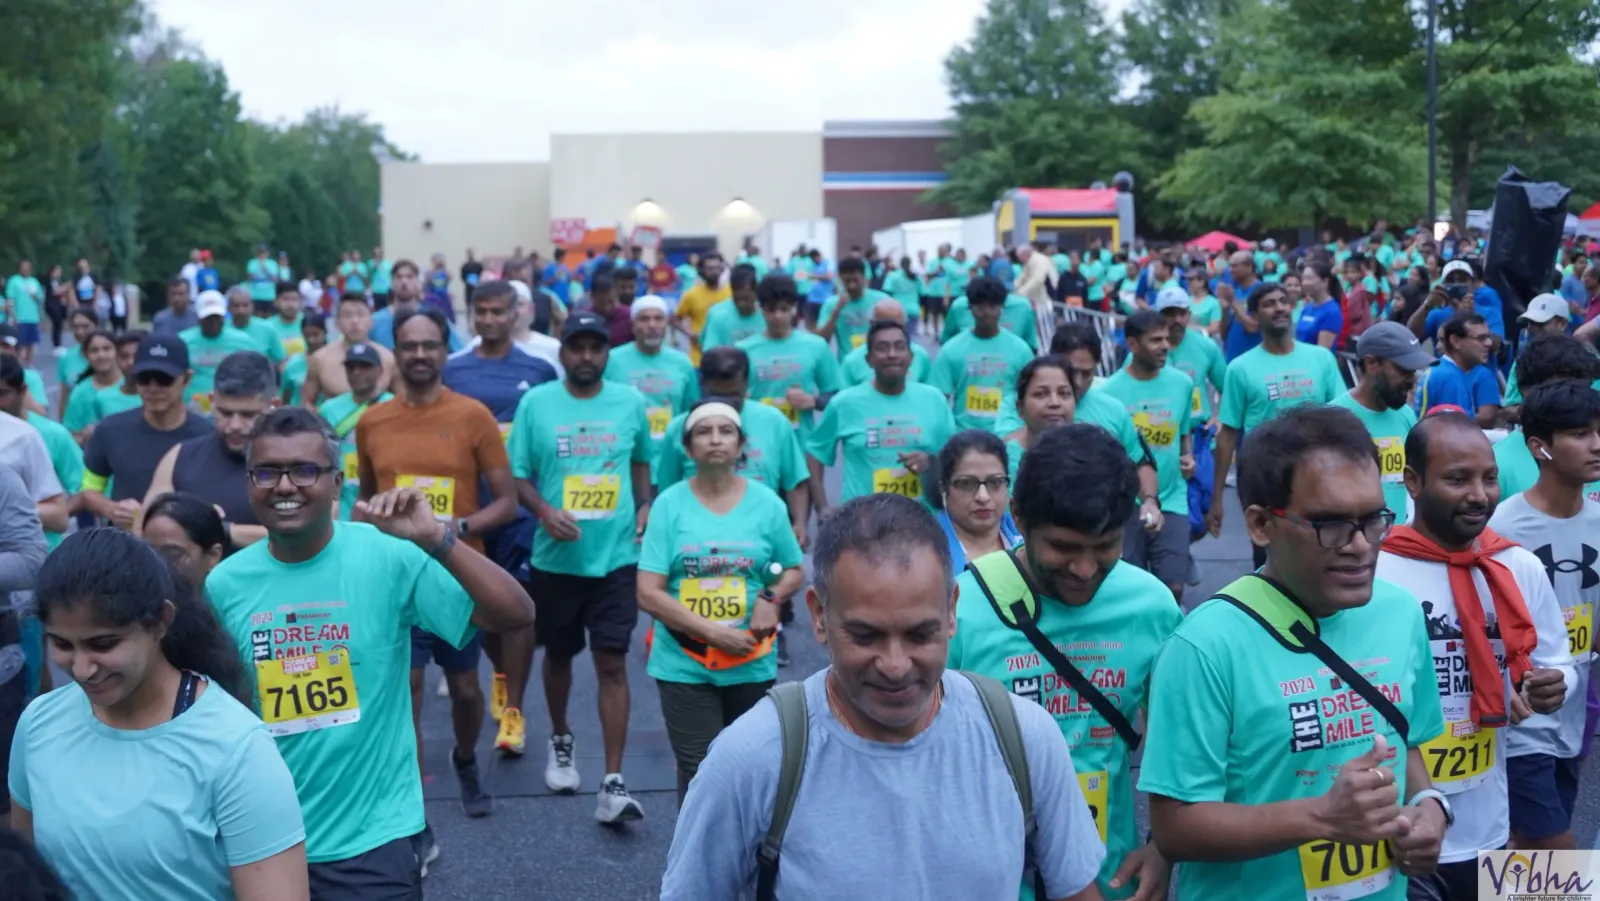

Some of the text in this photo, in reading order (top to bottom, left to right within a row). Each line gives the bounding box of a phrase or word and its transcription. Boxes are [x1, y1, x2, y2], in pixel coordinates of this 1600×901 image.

[569, 490, 615, 509] 7227
[685, 596, 741, 618] 7035
[252, 629, 271, 664] HE
[273, 624, 349, 645] DREAM
[1007, 653, 1040, 671] 2024
[1044, 669, 1126, 693] DRAM
[1280, 677, 1315, 696] 2024
[266, 676, 348, 718] 7165
[1045, 694, 1091, 714] MILE
[1321, 683, 1402, 718] DREM
[1290, 702, 1321, 751] THE
[1326, 713, 1375, 744] MILE
[1428, 738, 1492, 778] 7211
